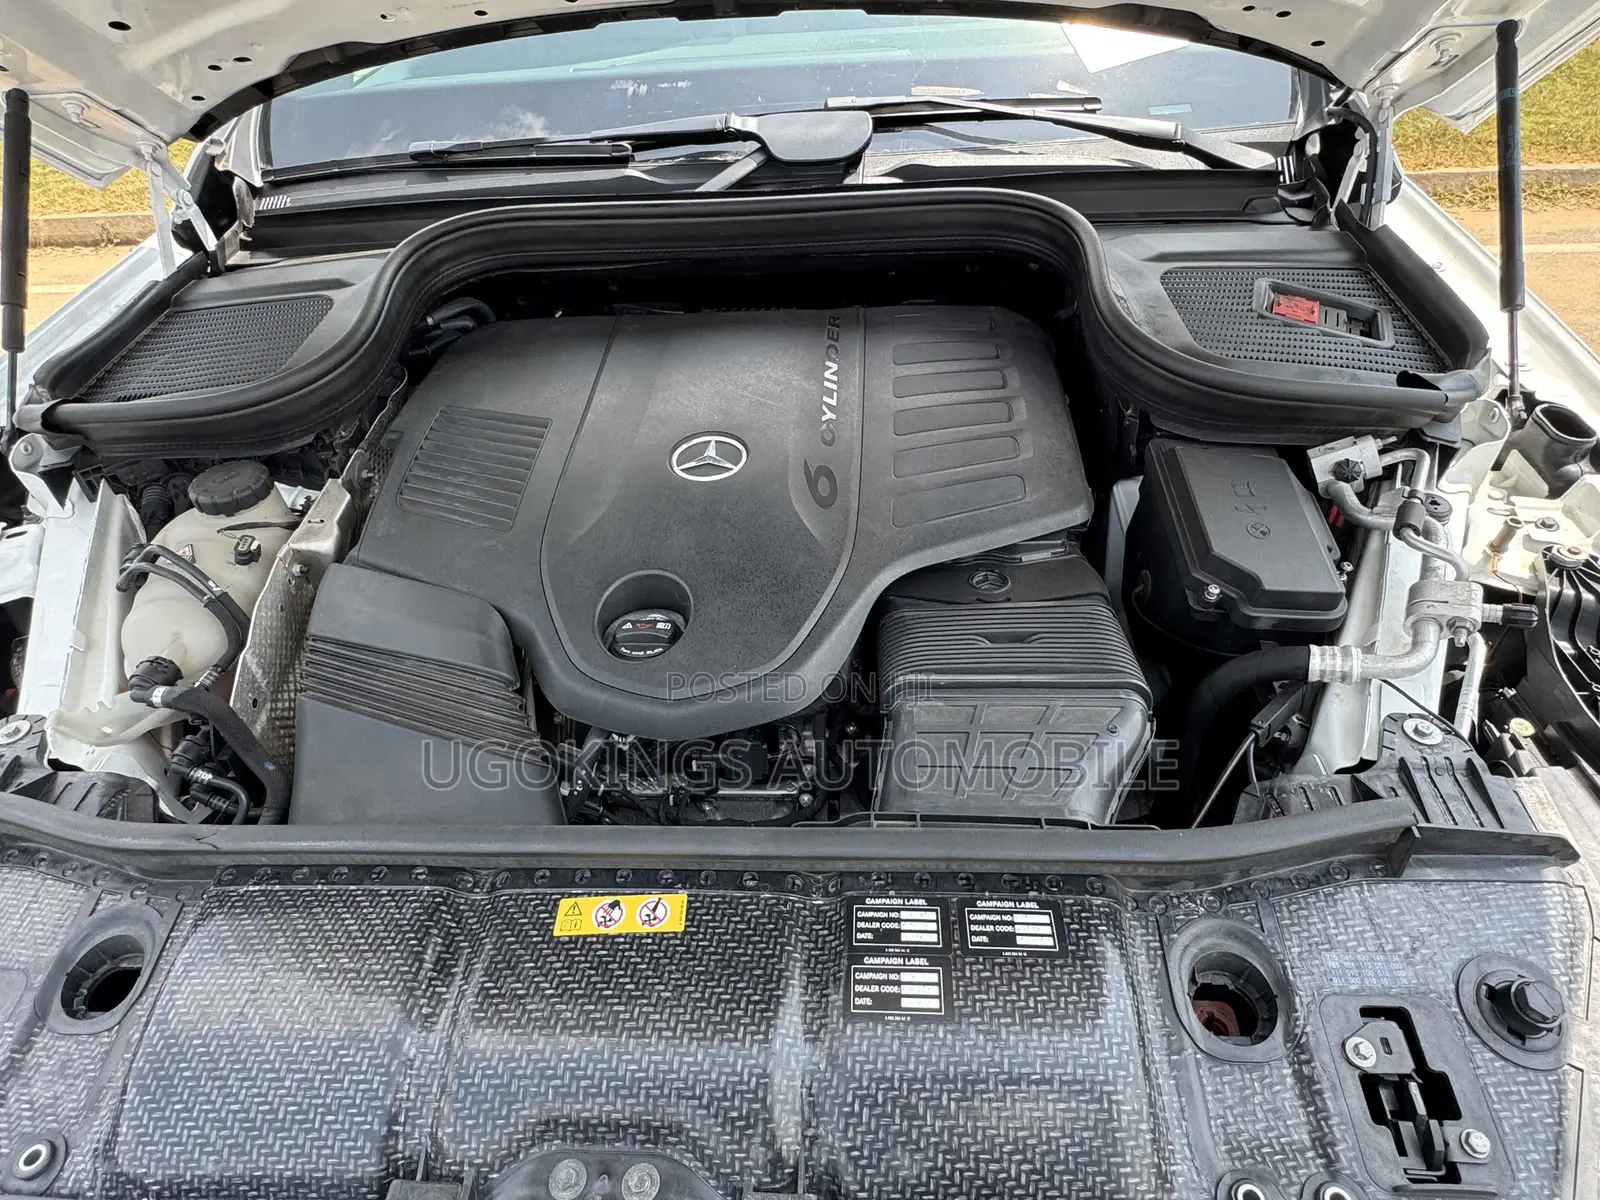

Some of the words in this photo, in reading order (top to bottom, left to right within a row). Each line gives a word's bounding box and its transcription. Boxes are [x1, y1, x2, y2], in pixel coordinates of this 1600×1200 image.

[820, 315, 841, 447] CYLINDER
[804, 457, 838, 509] 6
[855, 972, 888, 980] CAMPAIGN
[864, 957, 903, 965] CAMPAIGN
